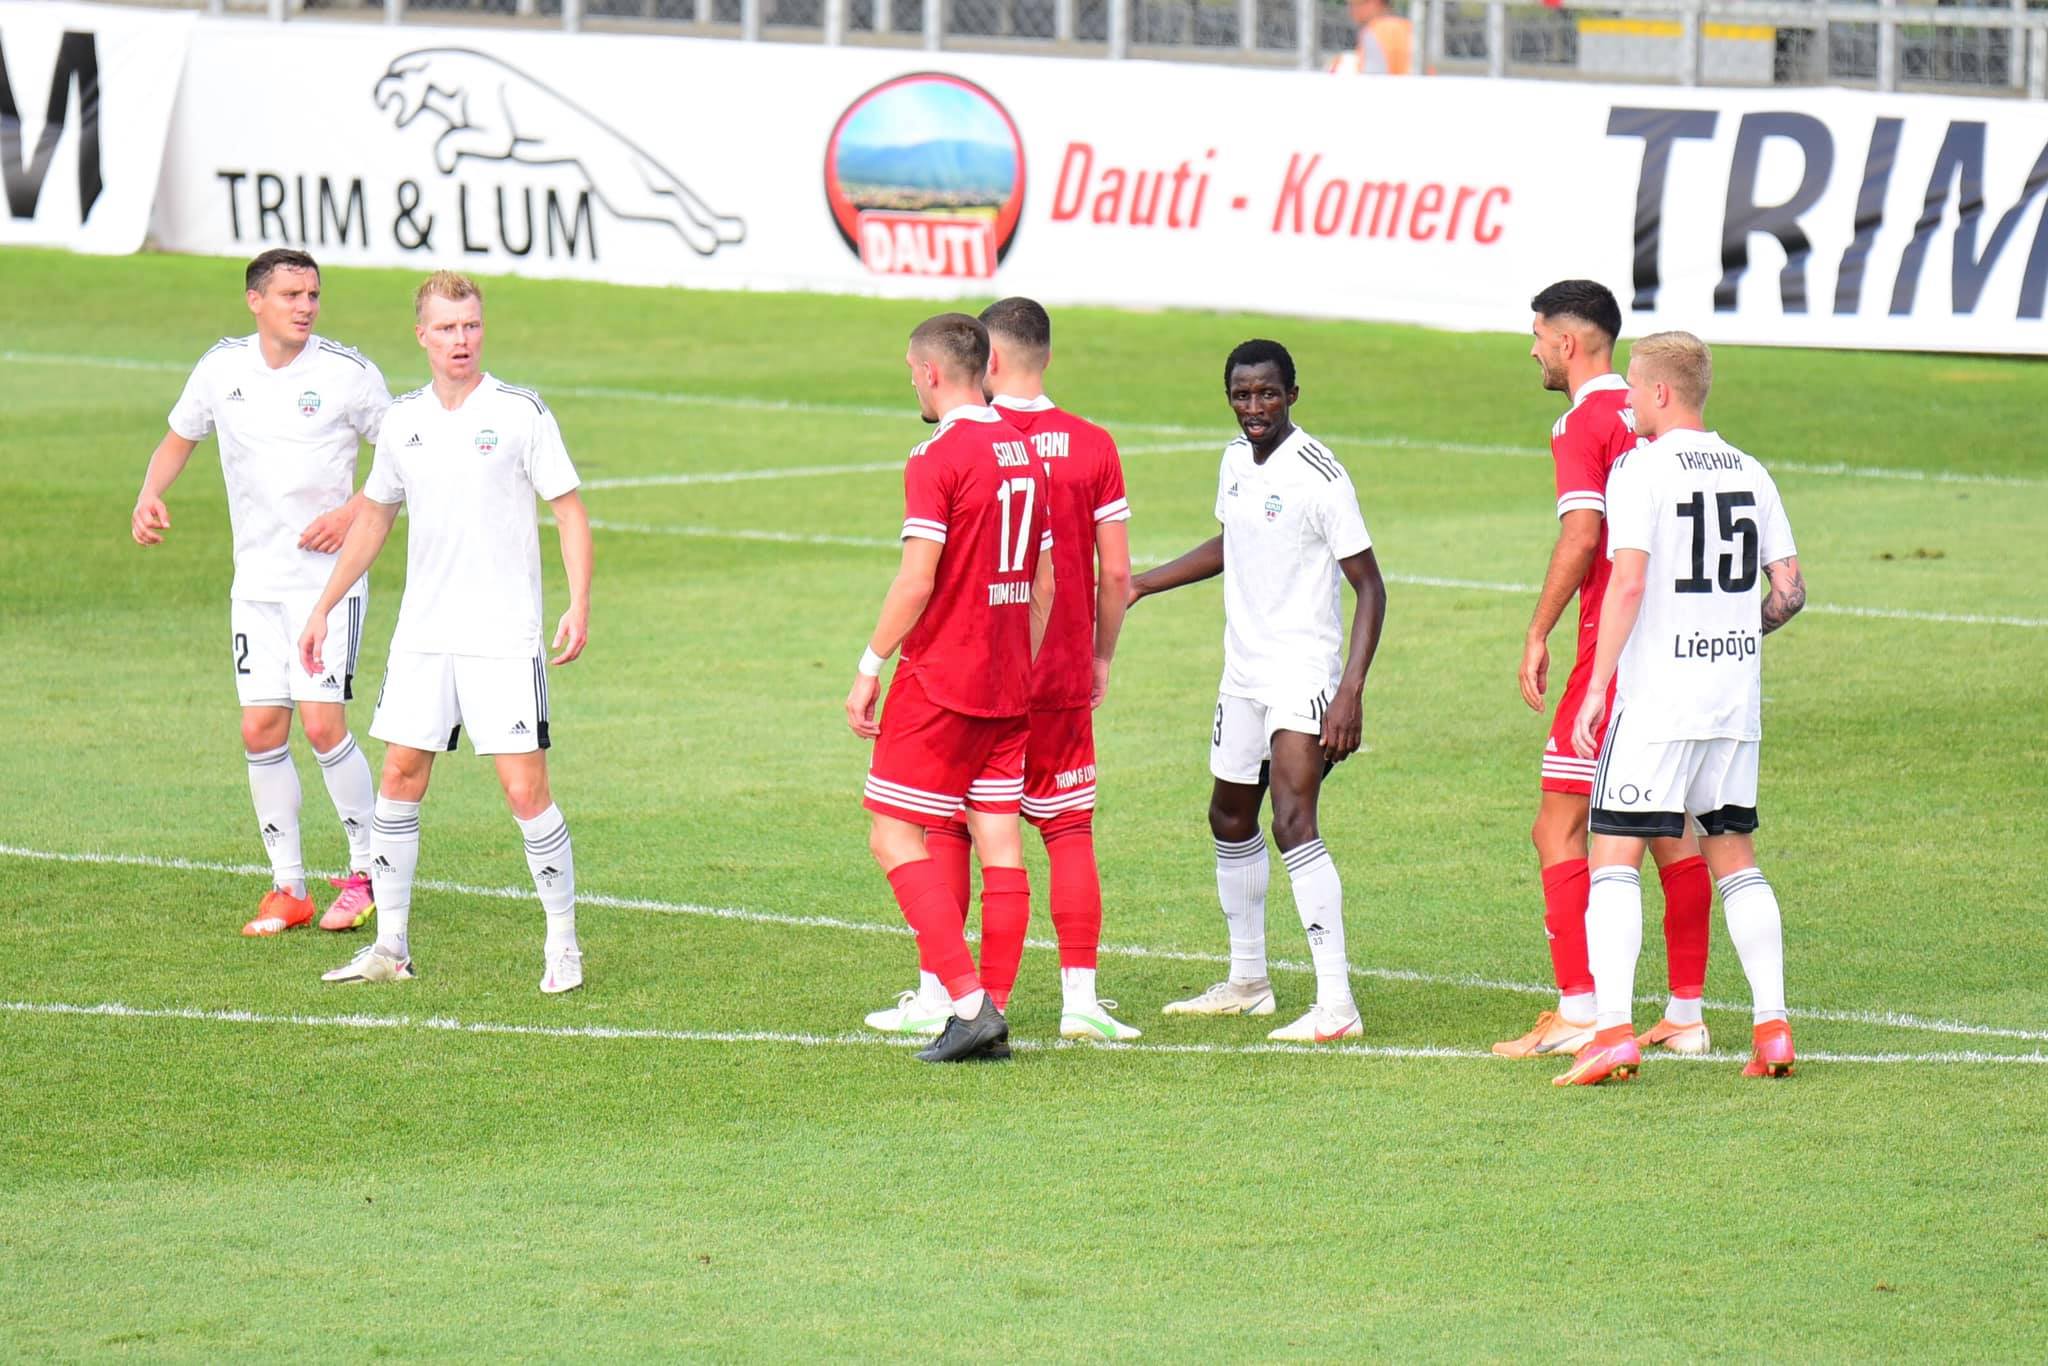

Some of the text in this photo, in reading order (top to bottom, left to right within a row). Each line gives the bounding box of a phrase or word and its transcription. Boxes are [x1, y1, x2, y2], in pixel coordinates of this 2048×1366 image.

[216, 170, 598, 263] TRIM & LUM
[1050, 141, 1511, 246] Dauti - Komerc
[863, 220, 988, 274] DAUTI
[1675, 452, 1743, 472] TKACHUK
[996, 477, 1036, 573] 17
[1674, 490, 1759, 594] 15
[235, 633, 251, 674] 2
[1674, 629, 1757, 663] Liepāja
